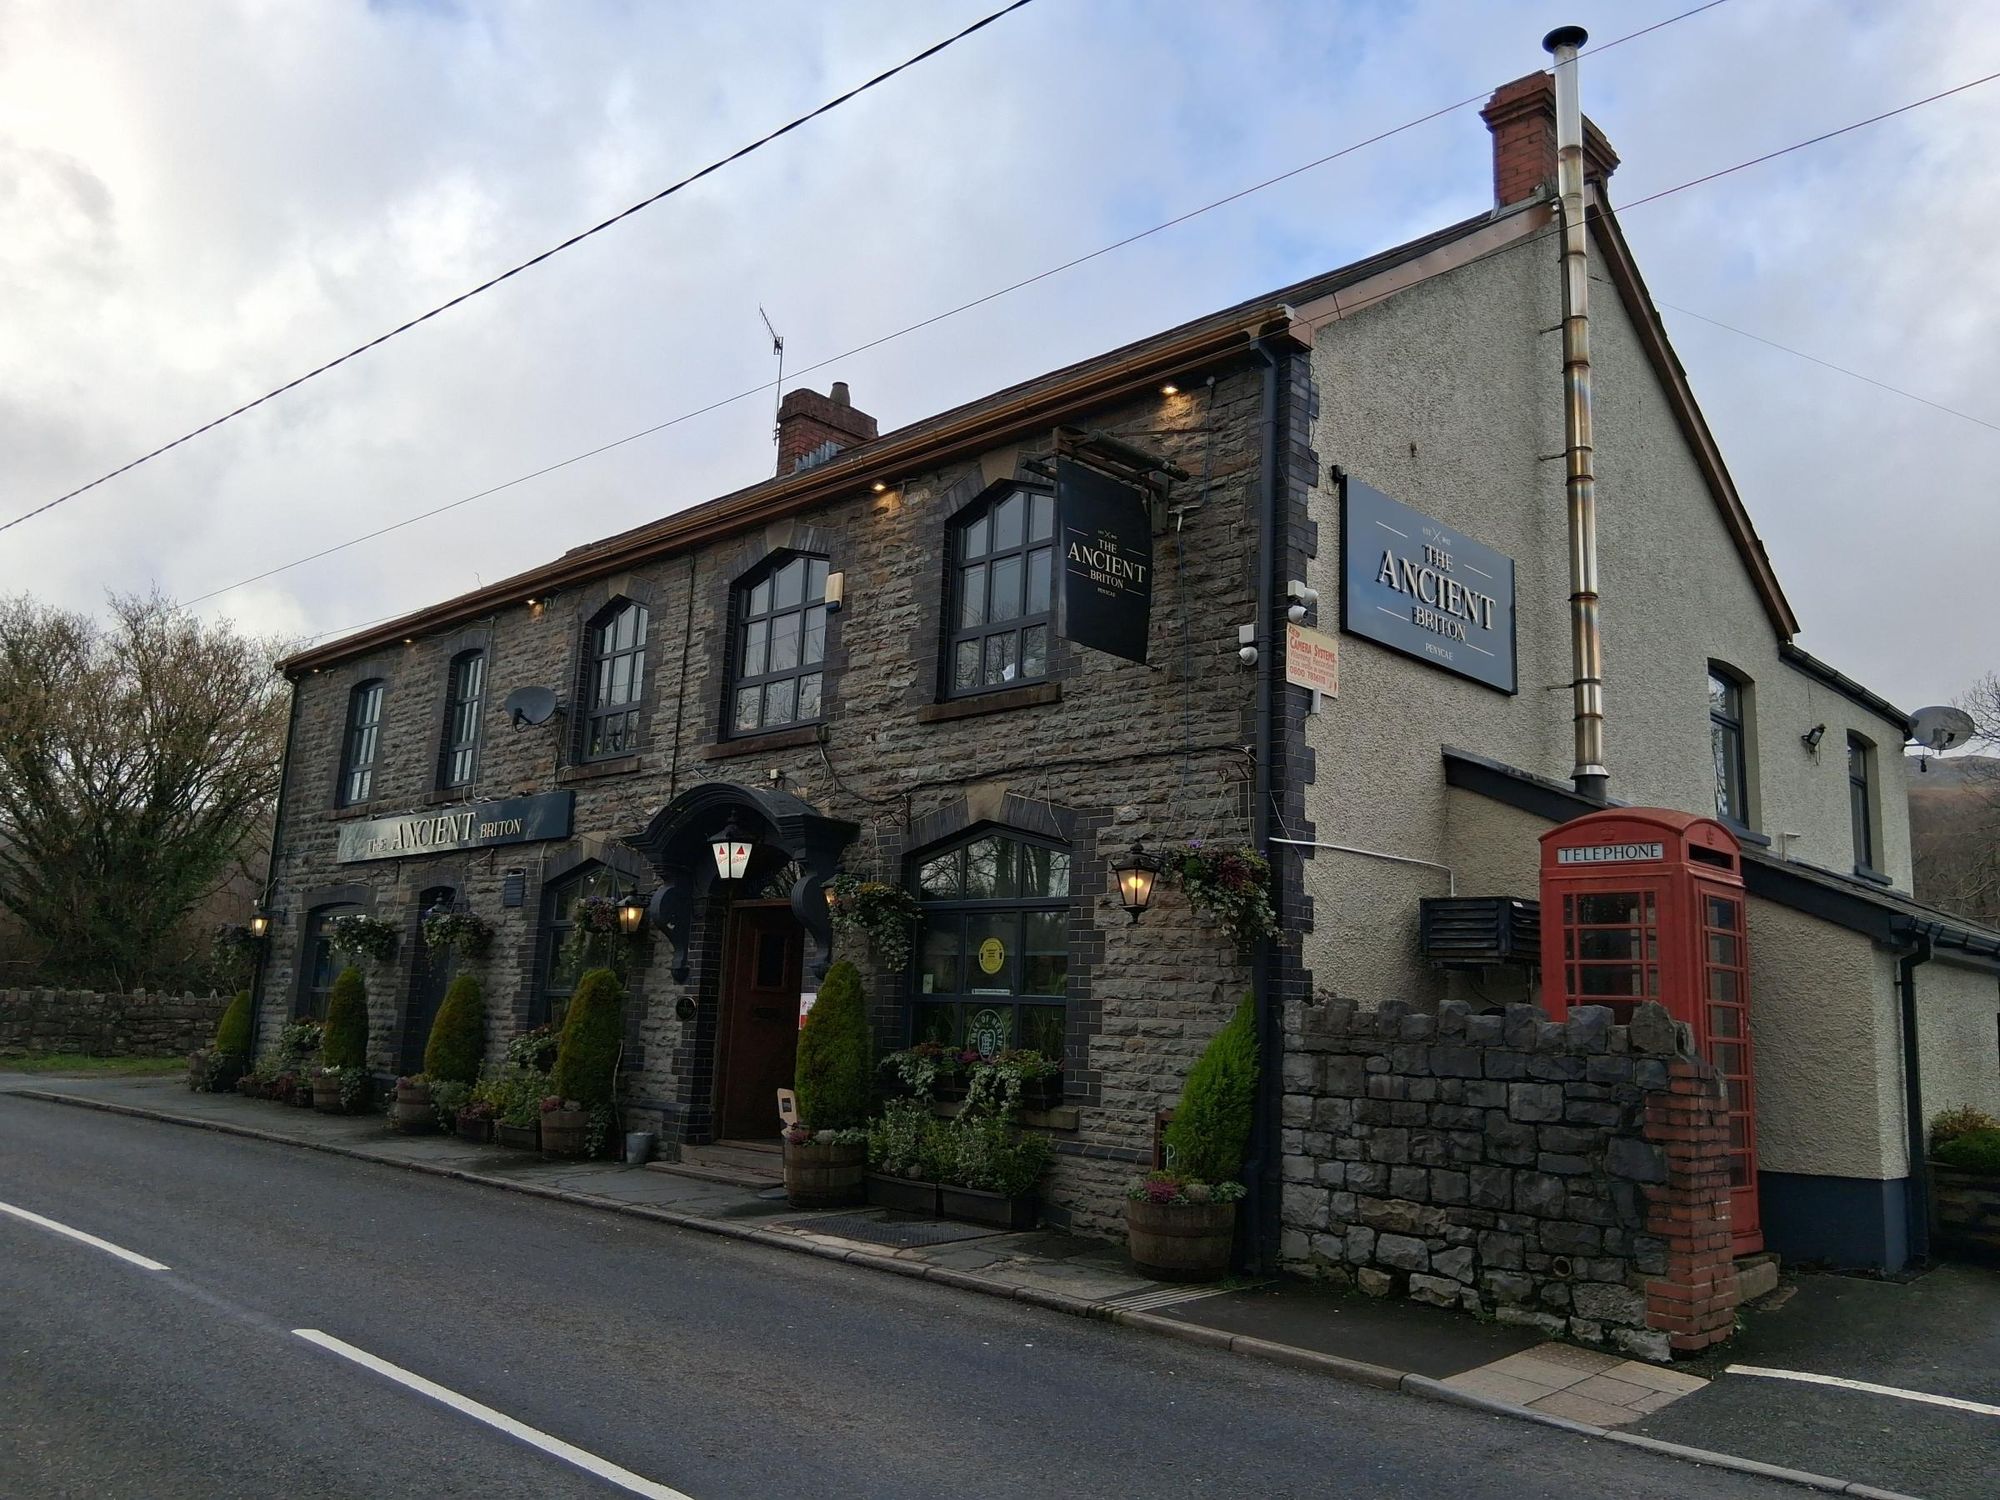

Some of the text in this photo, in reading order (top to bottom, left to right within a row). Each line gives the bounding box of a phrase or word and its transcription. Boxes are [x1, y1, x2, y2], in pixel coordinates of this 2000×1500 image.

[1067, 542, 1147, 583] ANCIENT
[1098, 539, 1117, 554] THE
[1424, 543, 1454, 574] THE
[1090, 569, 1124, 589] BRITON
[1377, 549, 1496, 630] ANCIENT
[1414, 605, 1466, 642] BRITON
[367, 812, 522, 853] THE ANCIENT BRITON
[1560, 843, 1660, 862] TELEPHONE
